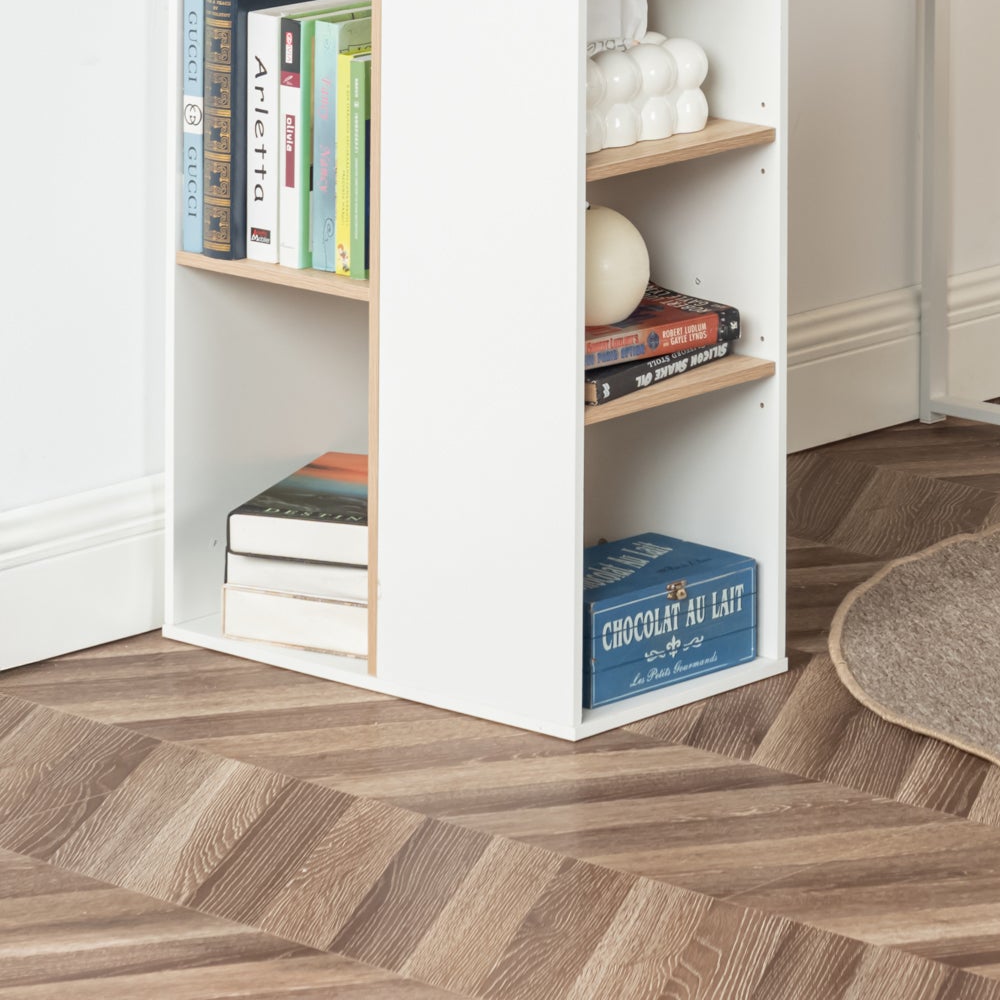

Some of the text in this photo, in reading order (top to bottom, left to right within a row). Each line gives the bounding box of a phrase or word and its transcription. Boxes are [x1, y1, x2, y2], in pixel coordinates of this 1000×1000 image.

[188, 11, 197, 82] GUCCI
[254, 55, 269, 202] Arletta
[286, 116, 295, 152] olivia
[188, 146, 197, 217] GUCCI
[662, 326, 683, 339] ROBERT
[684, 322, 707, 334] LUDLUM
[670, 334, 687, 346] GAYLE
[689, 331, 708, 342] LYNDS
[647, 355, 671, 368] STOLL
[690, 342, 728, 367] SILICON
[635, 371, 653, 388] OIL
[602, 584, 744, 652] CHOCOLAT AU LAIT
[629, 650, 718, 688] Les Petits Gourmands
